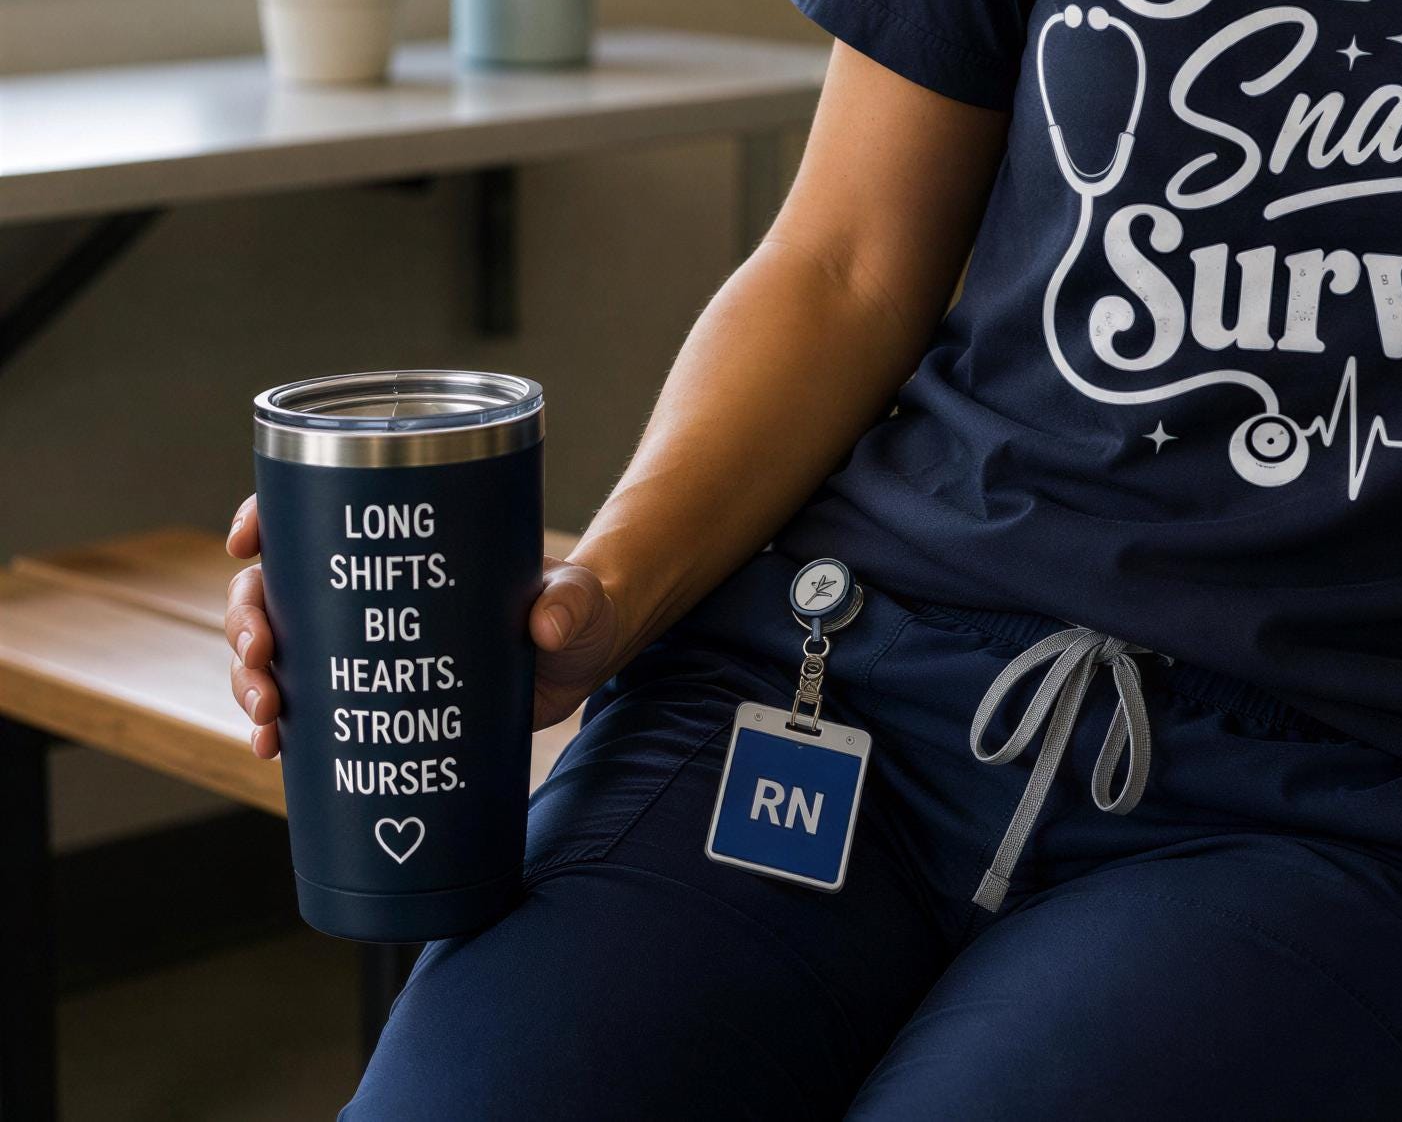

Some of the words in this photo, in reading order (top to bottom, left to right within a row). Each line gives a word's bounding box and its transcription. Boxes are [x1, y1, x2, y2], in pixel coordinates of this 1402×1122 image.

[345, 502, 435, 540] LONG
[329, 553, 456, 591] SHIFTS.
[364, 606, 421, 642] BIG
[330, 655, 463, 693] HEARTS.
[333, 705, 461, 744] STRONG
[334, 756, 466, 796] NURSES.
[750, 777, 825, 835] RN
